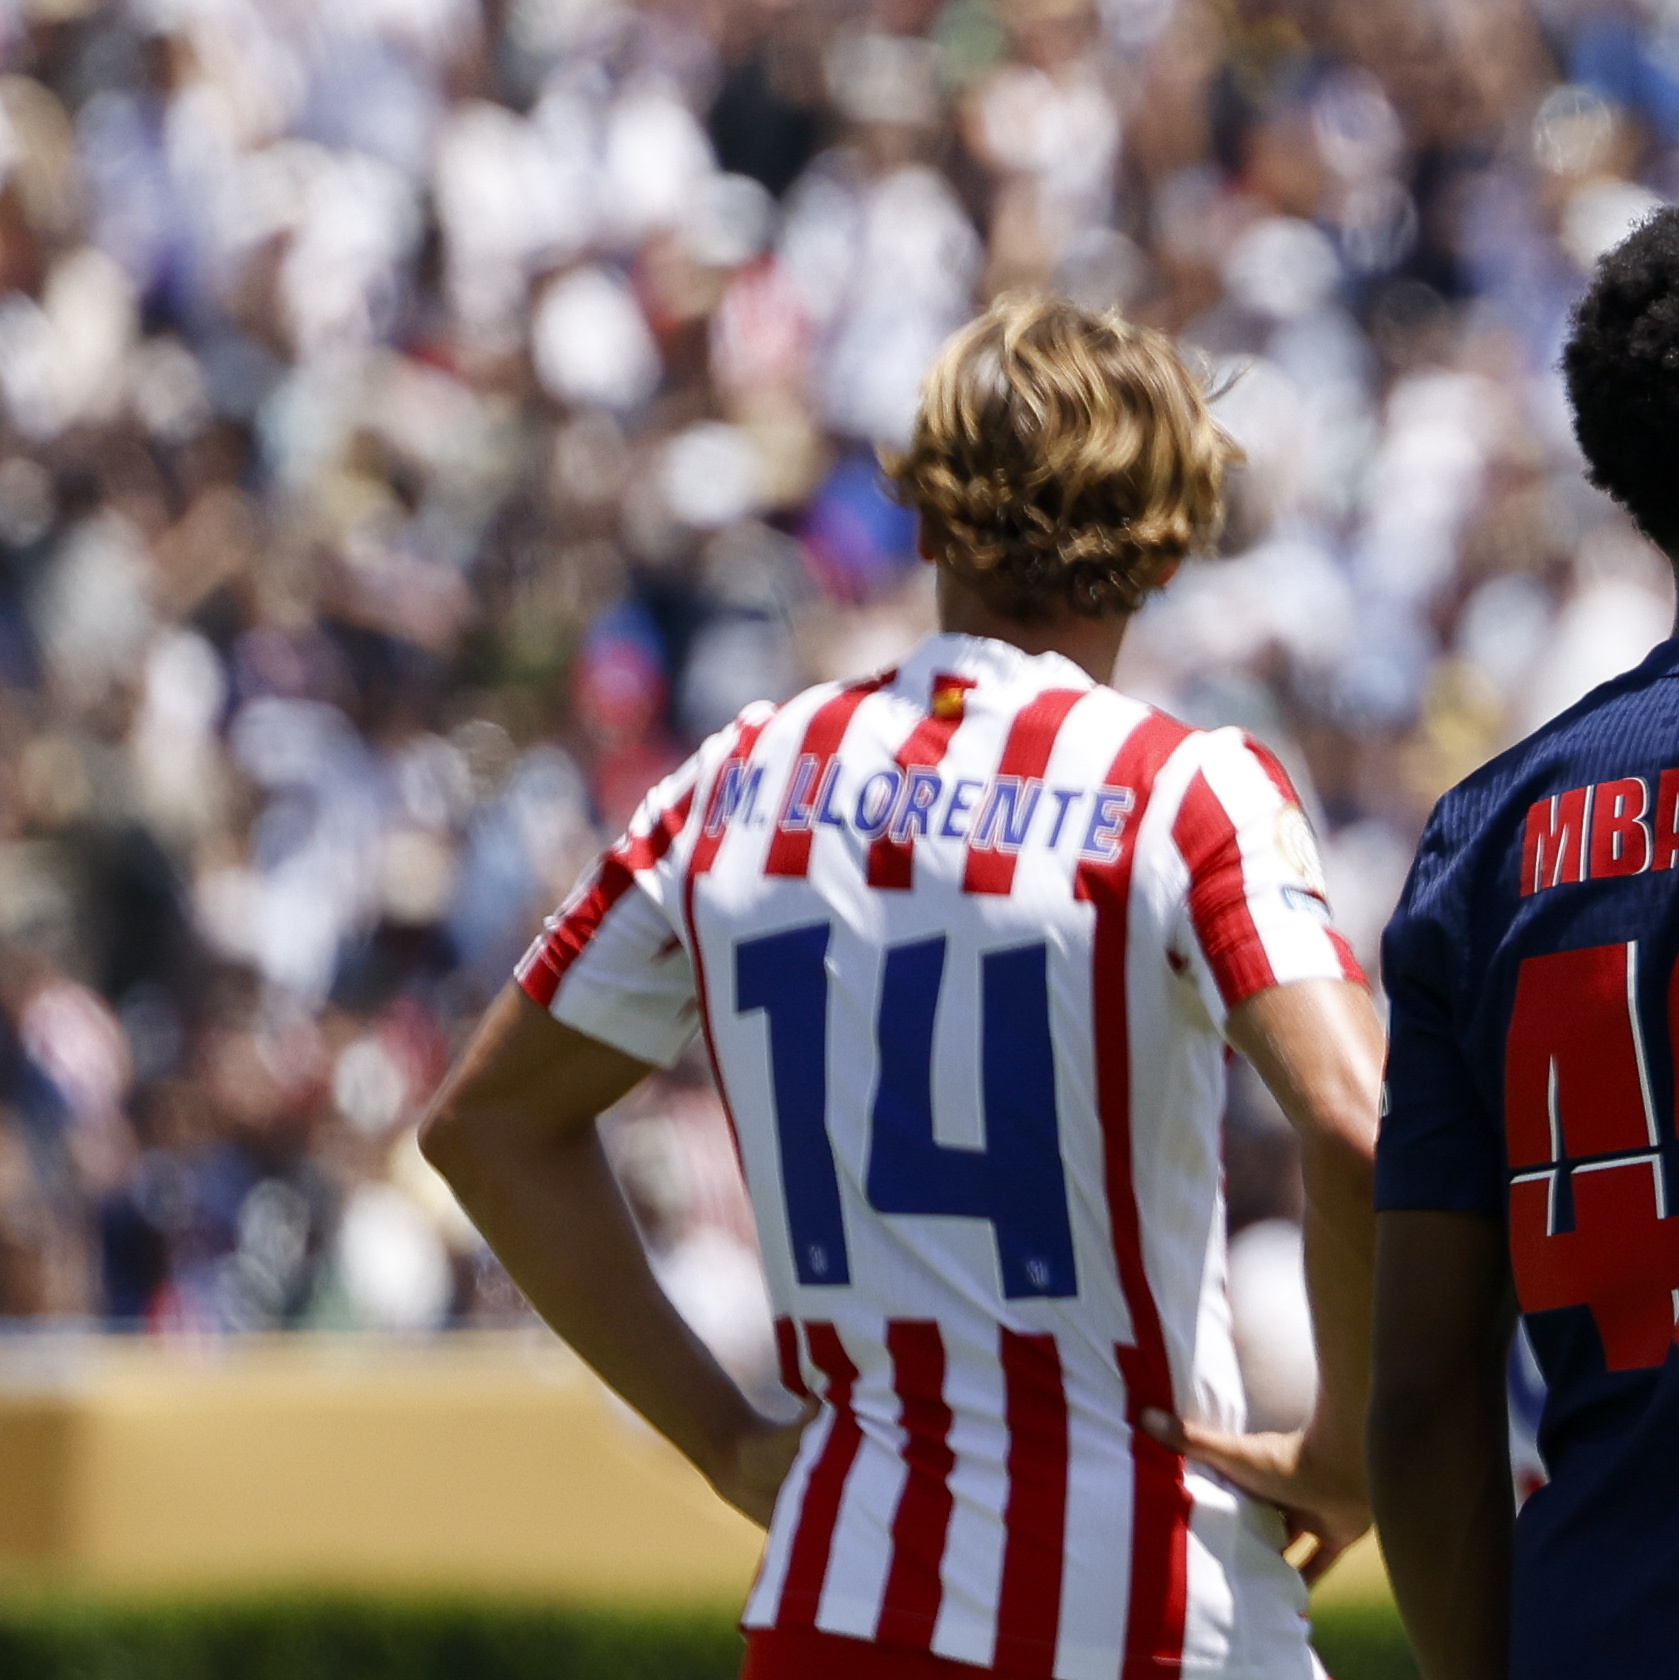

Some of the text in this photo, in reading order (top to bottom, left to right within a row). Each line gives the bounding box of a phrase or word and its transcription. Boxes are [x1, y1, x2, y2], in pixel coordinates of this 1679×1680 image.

[705, 753, 1136, 864] M. LLORENTE
[735, 920, 1079, 1300] 14
